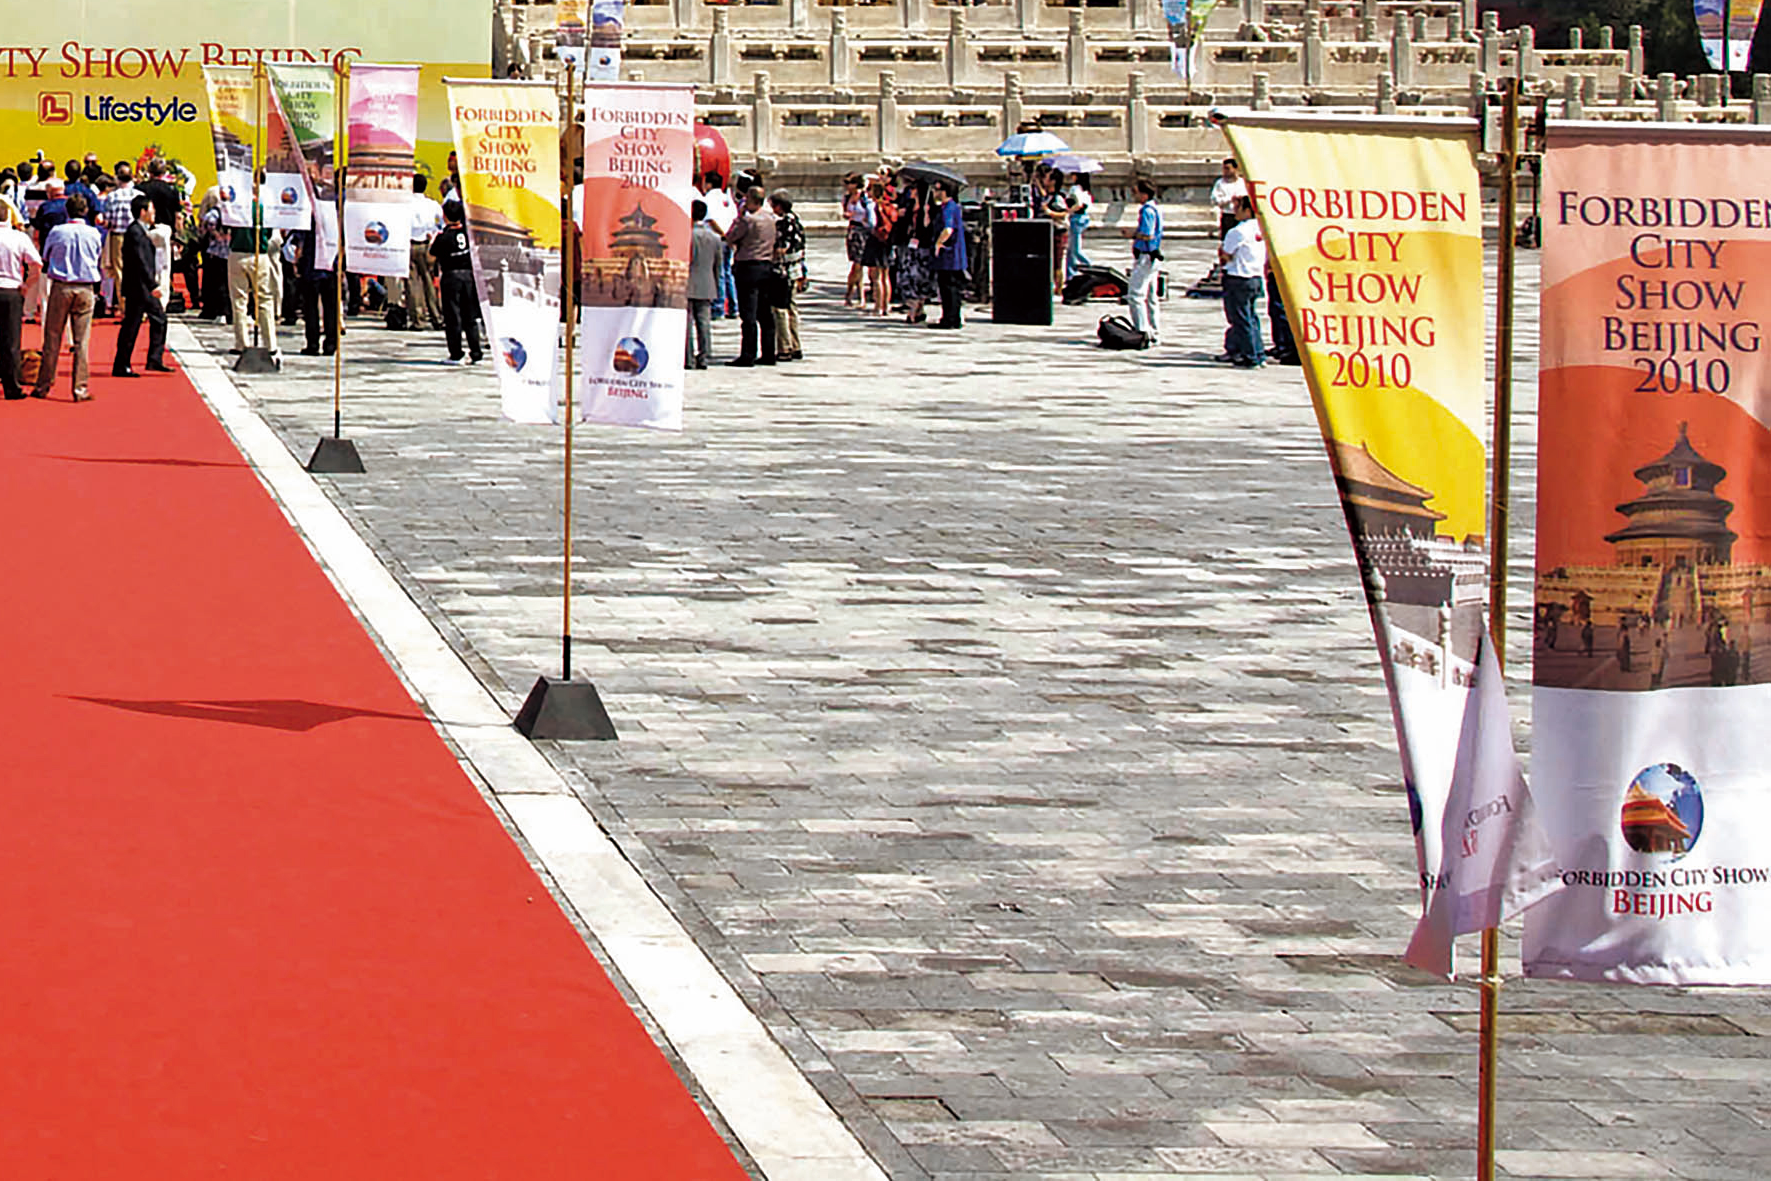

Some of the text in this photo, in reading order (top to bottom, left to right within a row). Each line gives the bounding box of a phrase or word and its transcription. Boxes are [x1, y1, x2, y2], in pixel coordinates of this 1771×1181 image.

[60, 41, 191, 79] SHOW
[84, 95, 197, 126] Lifestyle
[456, 106, 553, 122] FORBIDDEN
[591, 107, 688, 125] FORBIDDEN
[484, 124, 524, 139] CITY
[620, 125, 660, 141] CITY
[479, 140, 531, 155] SHOW
[614, 142, 666, 156] SHOW
[473, 156, 537, 174] BEIJING
[608, 157, 671, 174] BEIJING
[487, 174, 525, 189] 2010
[620, 174, 659, 189] 2010
[1247, 180, 1467, 222] FORBIDDEN
[1557, 191, 1771, 228] FORBIDDE
[456, 233, 466, 249] 9
[1316, 225, 1405, 262] CITY
[1630, 233, 1727, 269] CITY
[1307, 266, 1422, 304] SHOW
[1616, 274, 1746, 311] SHOW
[1300, 308, 1435, 352] BEIJING
[1601, 316, 1762, 359] BEIJING
[1329, 352, 1412, 388] 2010
[1633, 357, 1731, 394] 2010
[1671, 868, 1708, 887] CITY
[1712, 866, 1770, 884] SHOW
[1612, 889, 1713, 920] BEIJING
